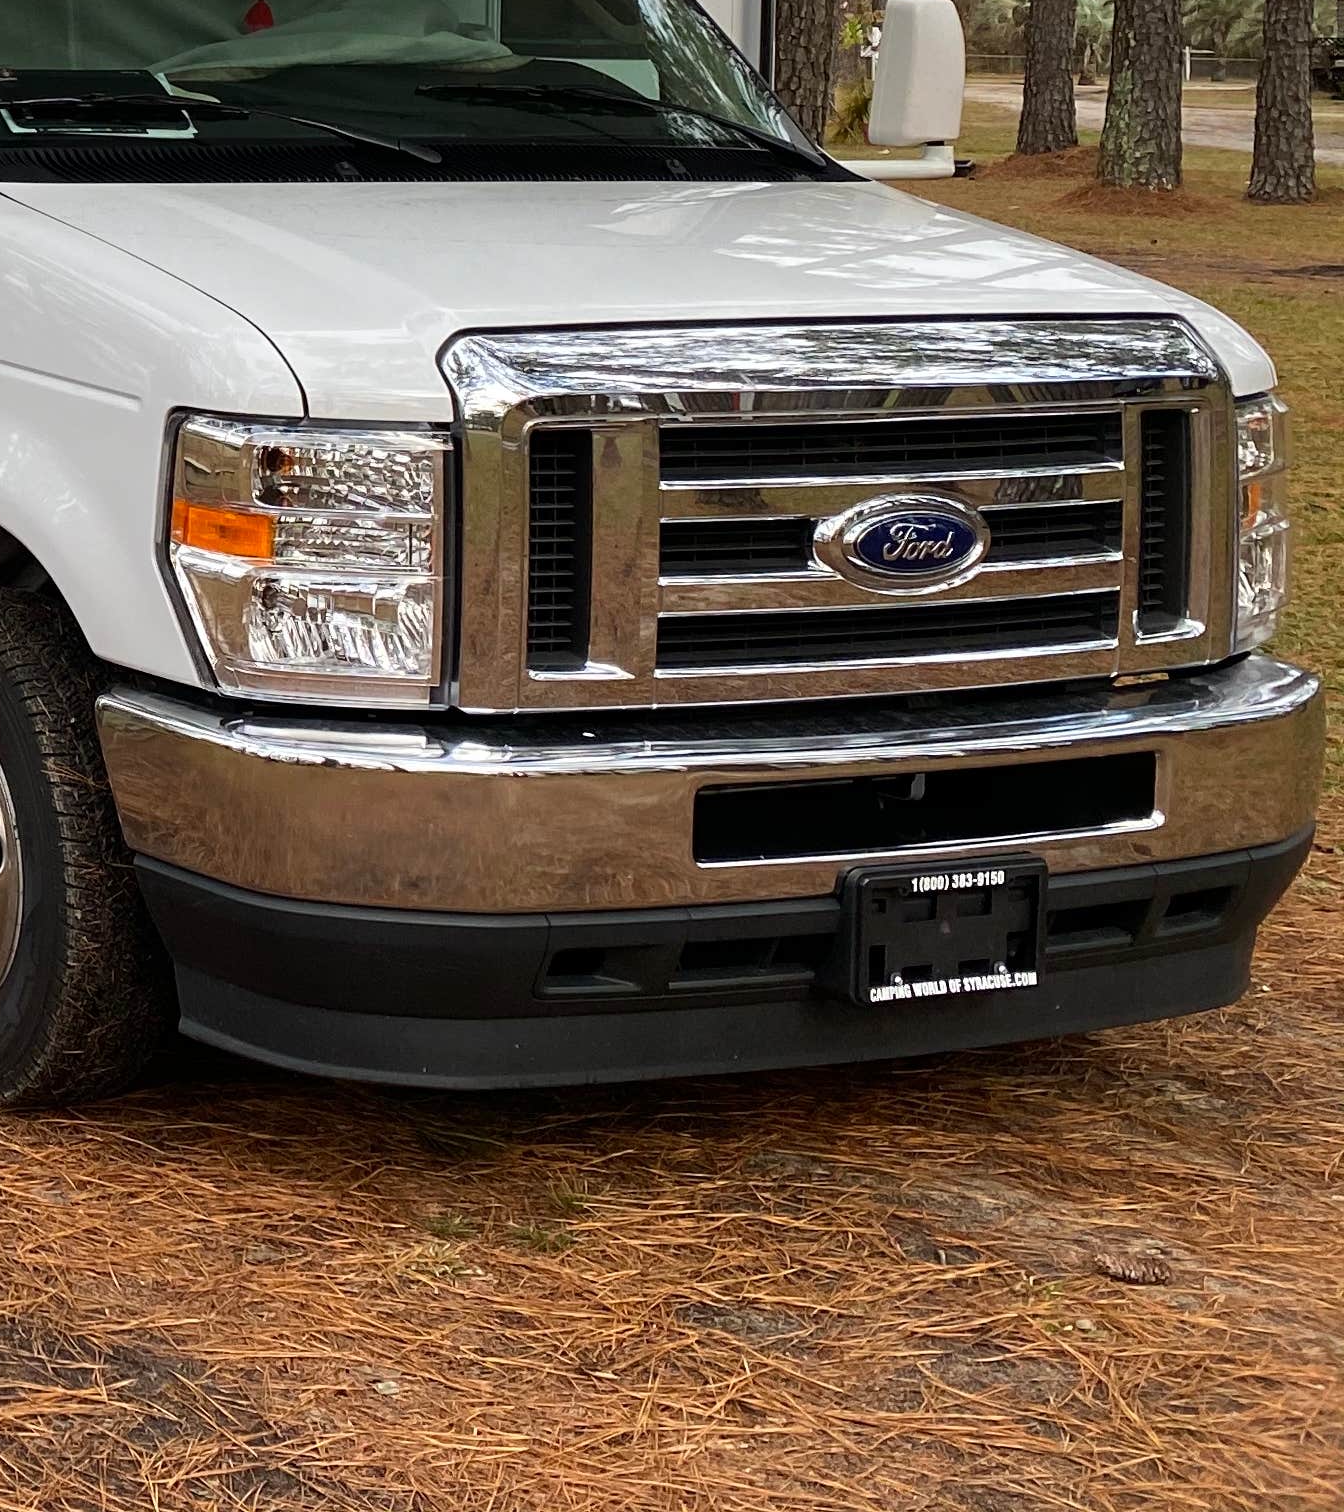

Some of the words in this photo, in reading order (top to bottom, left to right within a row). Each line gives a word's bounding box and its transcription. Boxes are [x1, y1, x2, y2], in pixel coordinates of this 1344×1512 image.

[883, 522, 954, 561] Ford
[870, 984, 912, 1002] CAMPING
[912, 980, 948, 997] WORLD
[948, 978, 962, 993] OF
[963, 971, 1038, 992] SYRACUSE.COM
